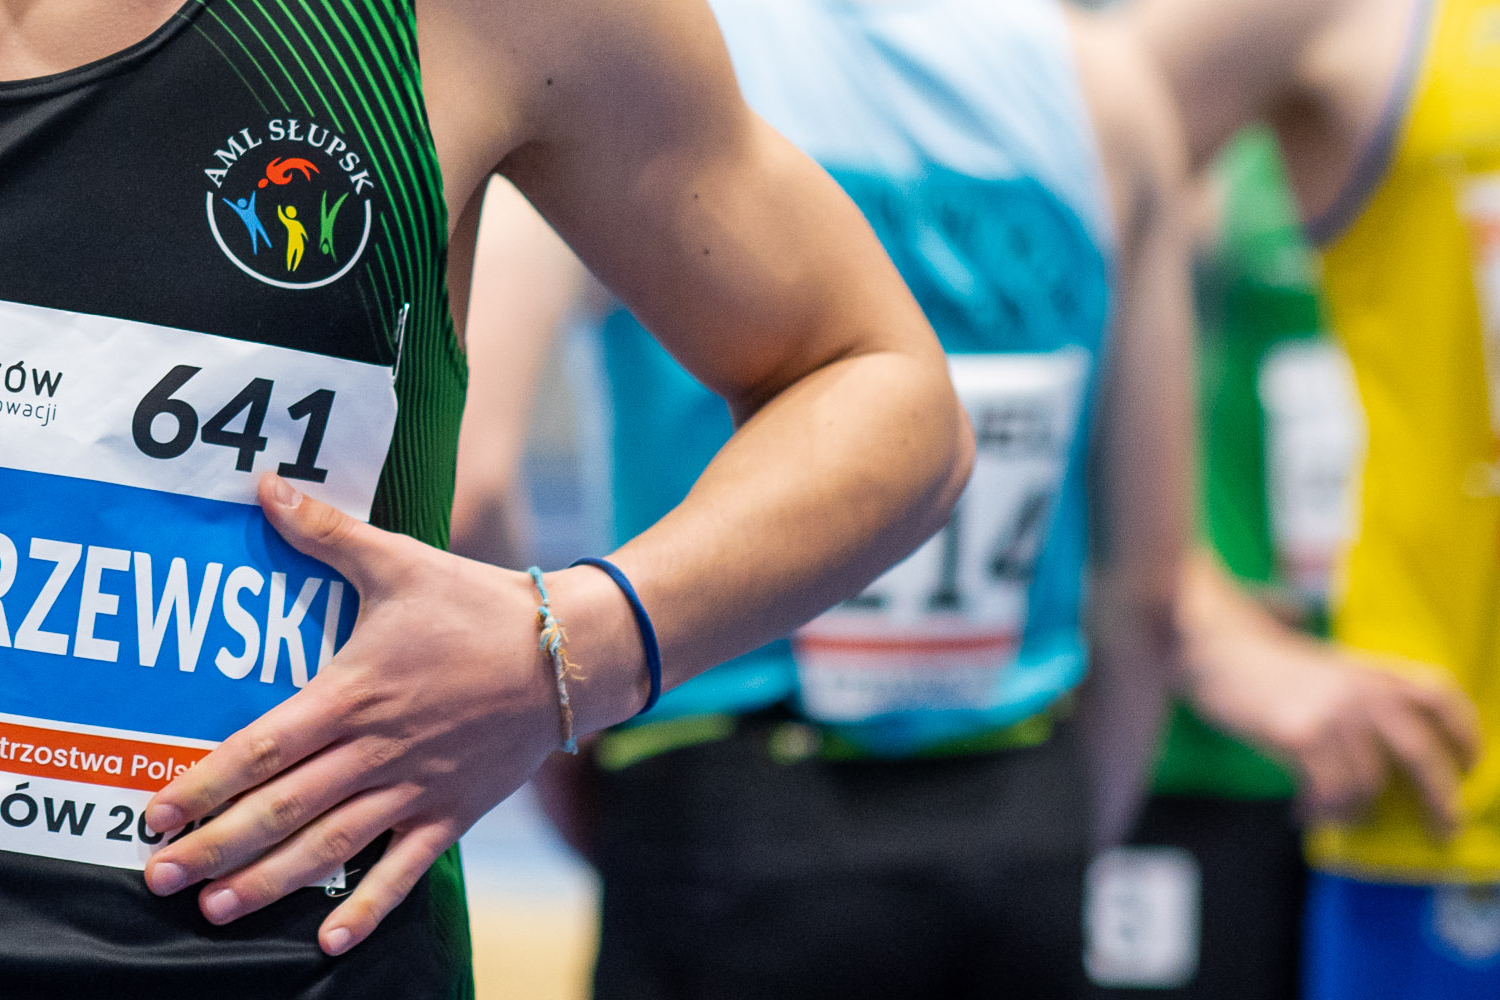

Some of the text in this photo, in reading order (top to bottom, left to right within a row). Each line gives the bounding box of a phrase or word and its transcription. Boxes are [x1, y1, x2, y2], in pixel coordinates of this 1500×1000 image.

[204, 119, 375, 195] AML SŁUPSK
[131, 364, 337, 484] 641
[130, 754, 199, 782] Pols
[105, 804, 215, 846] 20
